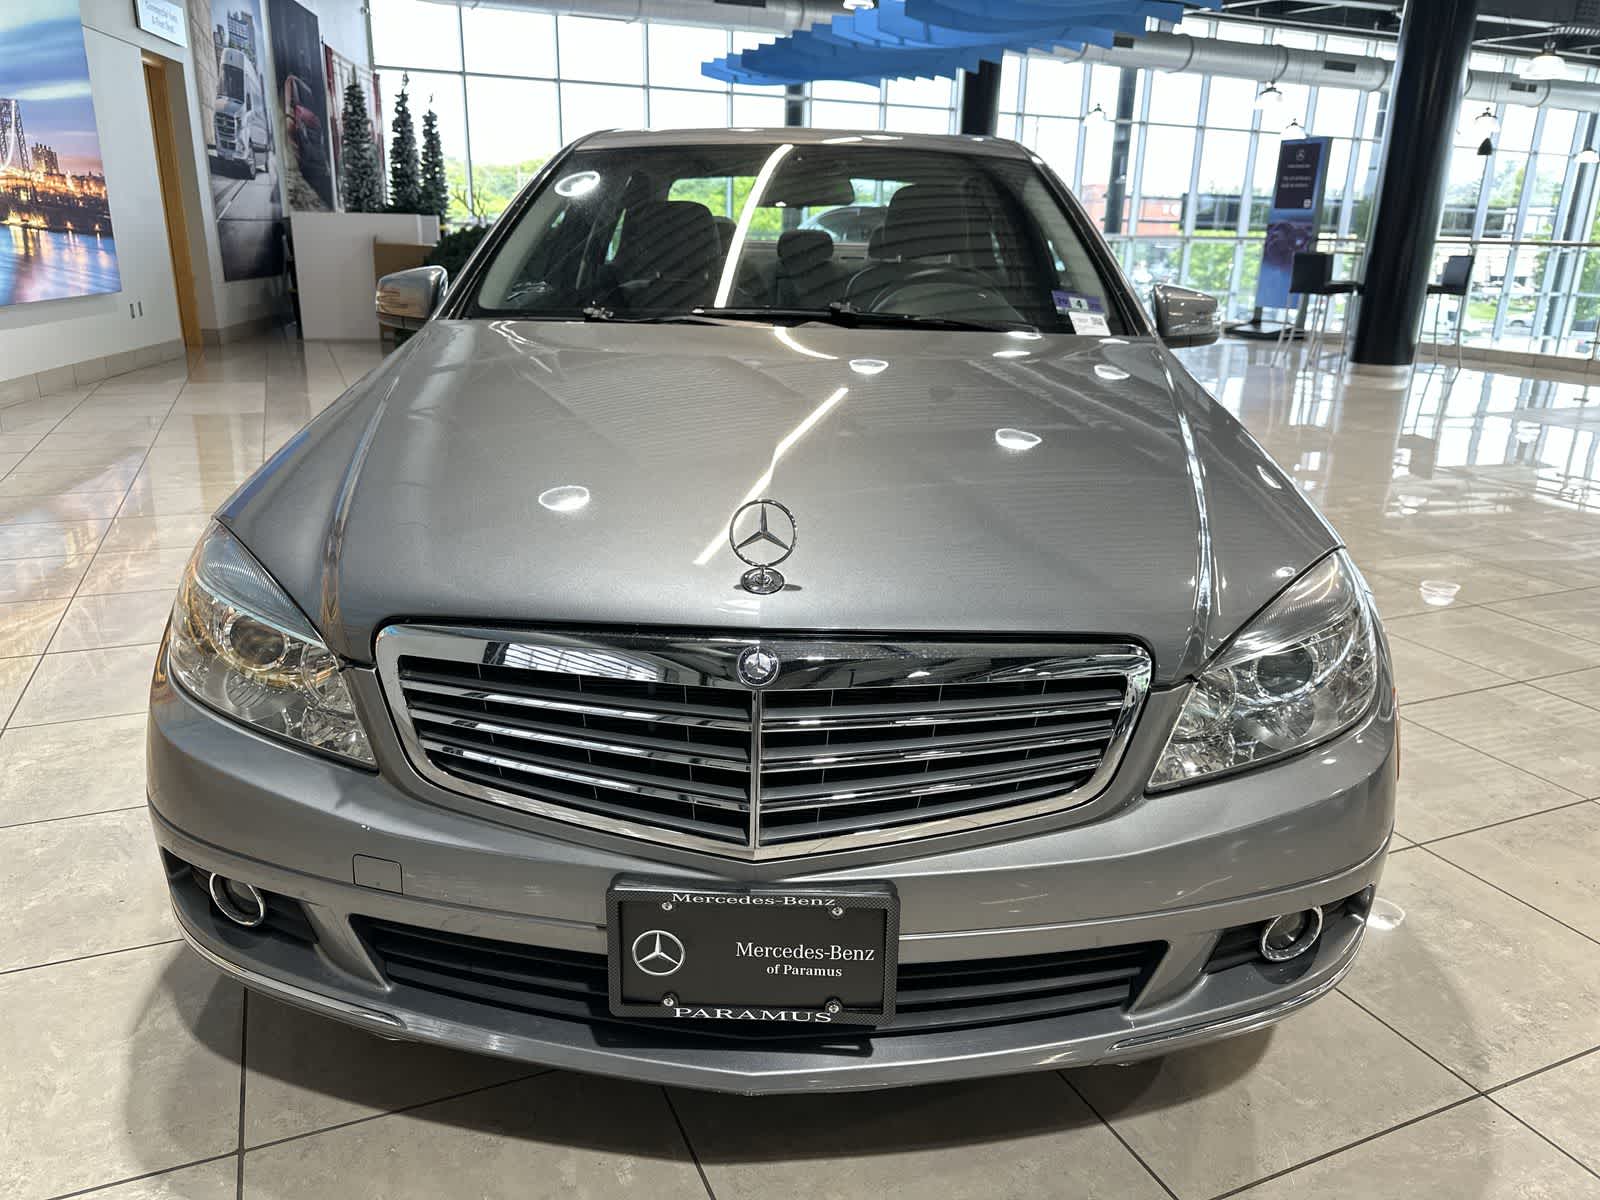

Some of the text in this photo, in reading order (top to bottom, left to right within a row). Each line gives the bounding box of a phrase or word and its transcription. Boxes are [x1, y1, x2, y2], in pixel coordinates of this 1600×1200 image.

[671, 893, 836, 906] Mercedes-Benz
[735, 941, 875, 961] Mercedes-Benz
[766, 964, 843, 977] of Paramus
[674, 1007, 833, 1022] PARAMUS
